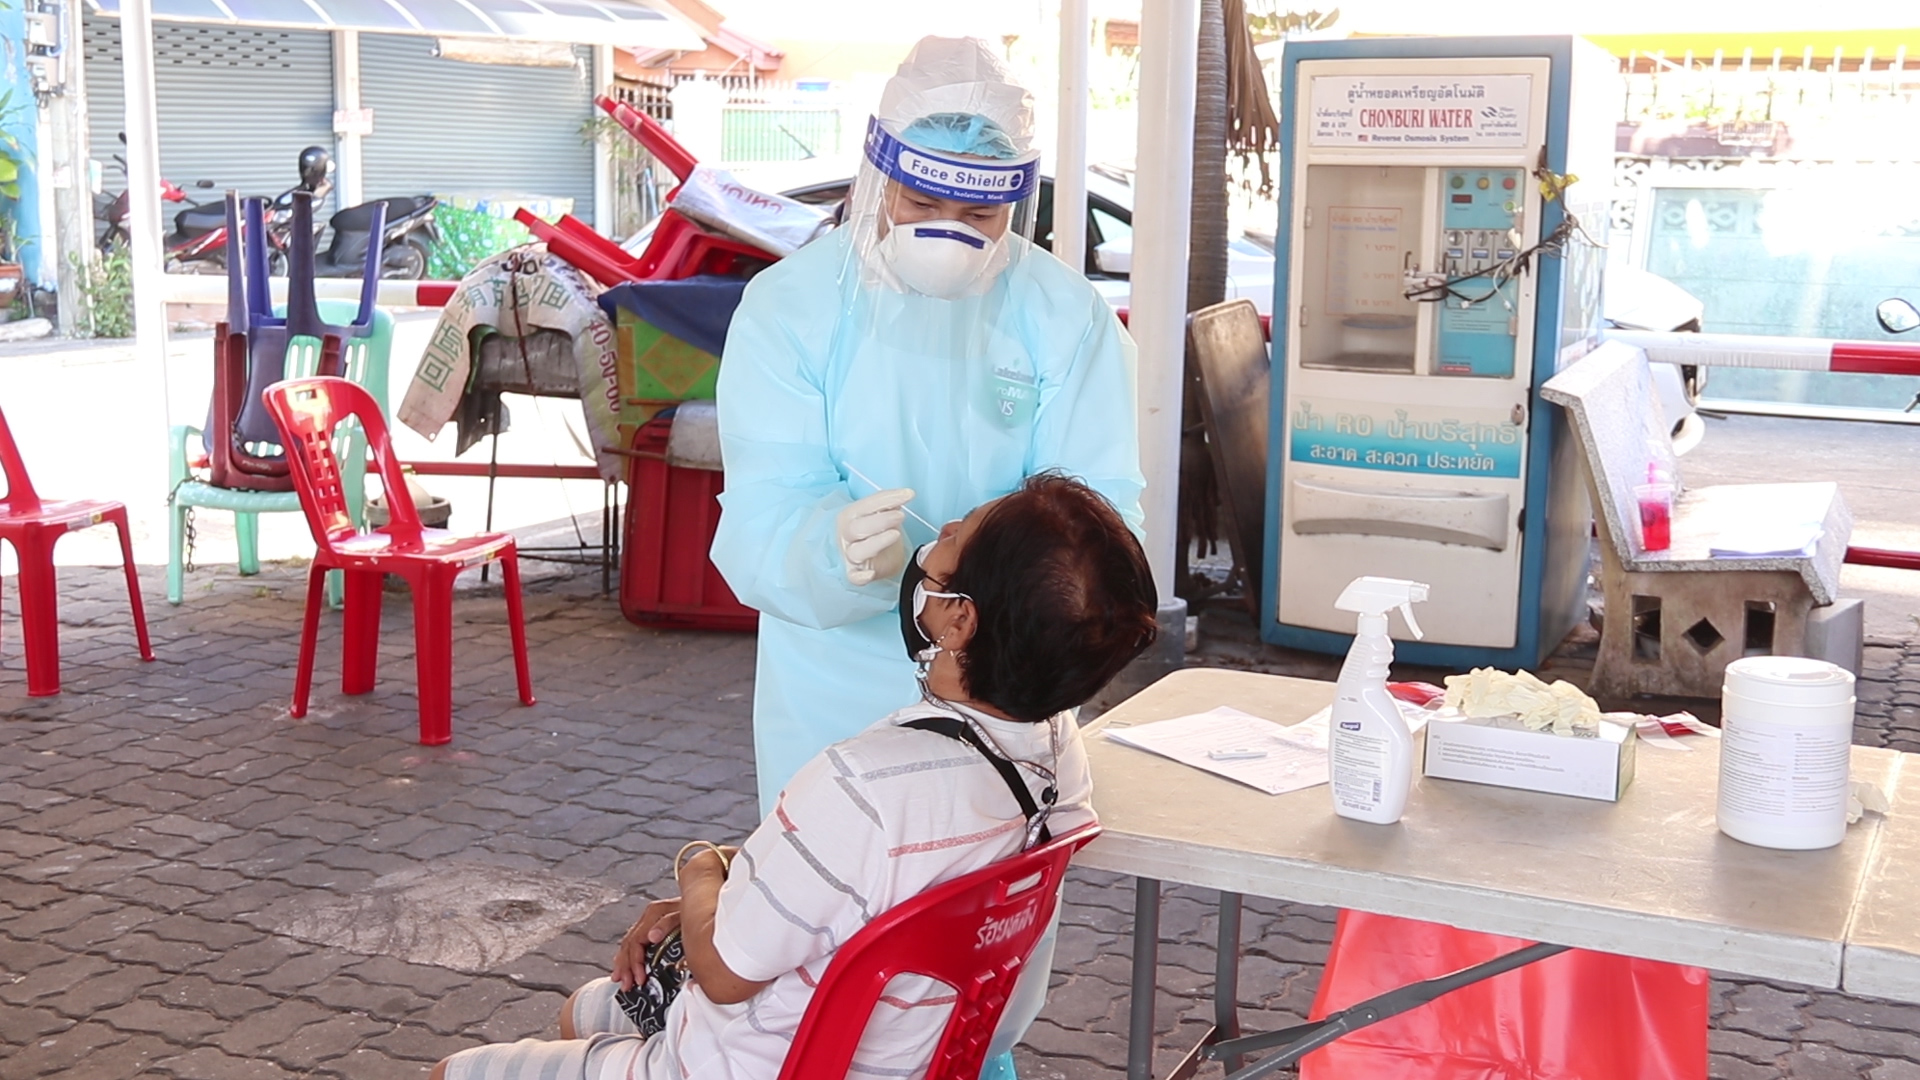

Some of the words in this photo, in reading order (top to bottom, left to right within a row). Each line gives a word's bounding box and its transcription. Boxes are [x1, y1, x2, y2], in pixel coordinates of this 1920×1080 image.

[1360, 109, 1425, 128] CHONBURI
[1428, 109, 1473, 128] WATER
[1371, 134, 1402, 142] Reverse
[1404, 134, 1437, 142] Osmosis
[1439, 134, 1470, 143] System
[911, 159, 949, 180] Face
[954, 171, 1007, 187] Shield
[915, 180, 950, 195] Protective
[953, 190, 984, 199] Isolation
[1292, 401, 1324, 431] น้ำ
[1336, 412, 1373, 437] RO
[1387, 408, 1518, 450] น้ำบริสุทธิ
[1310, 443, 1357, 462] สะอาด
[1365, 447, 1418, 467] สะดวก
[1426, 451, 1495, 471] ประหยัด
